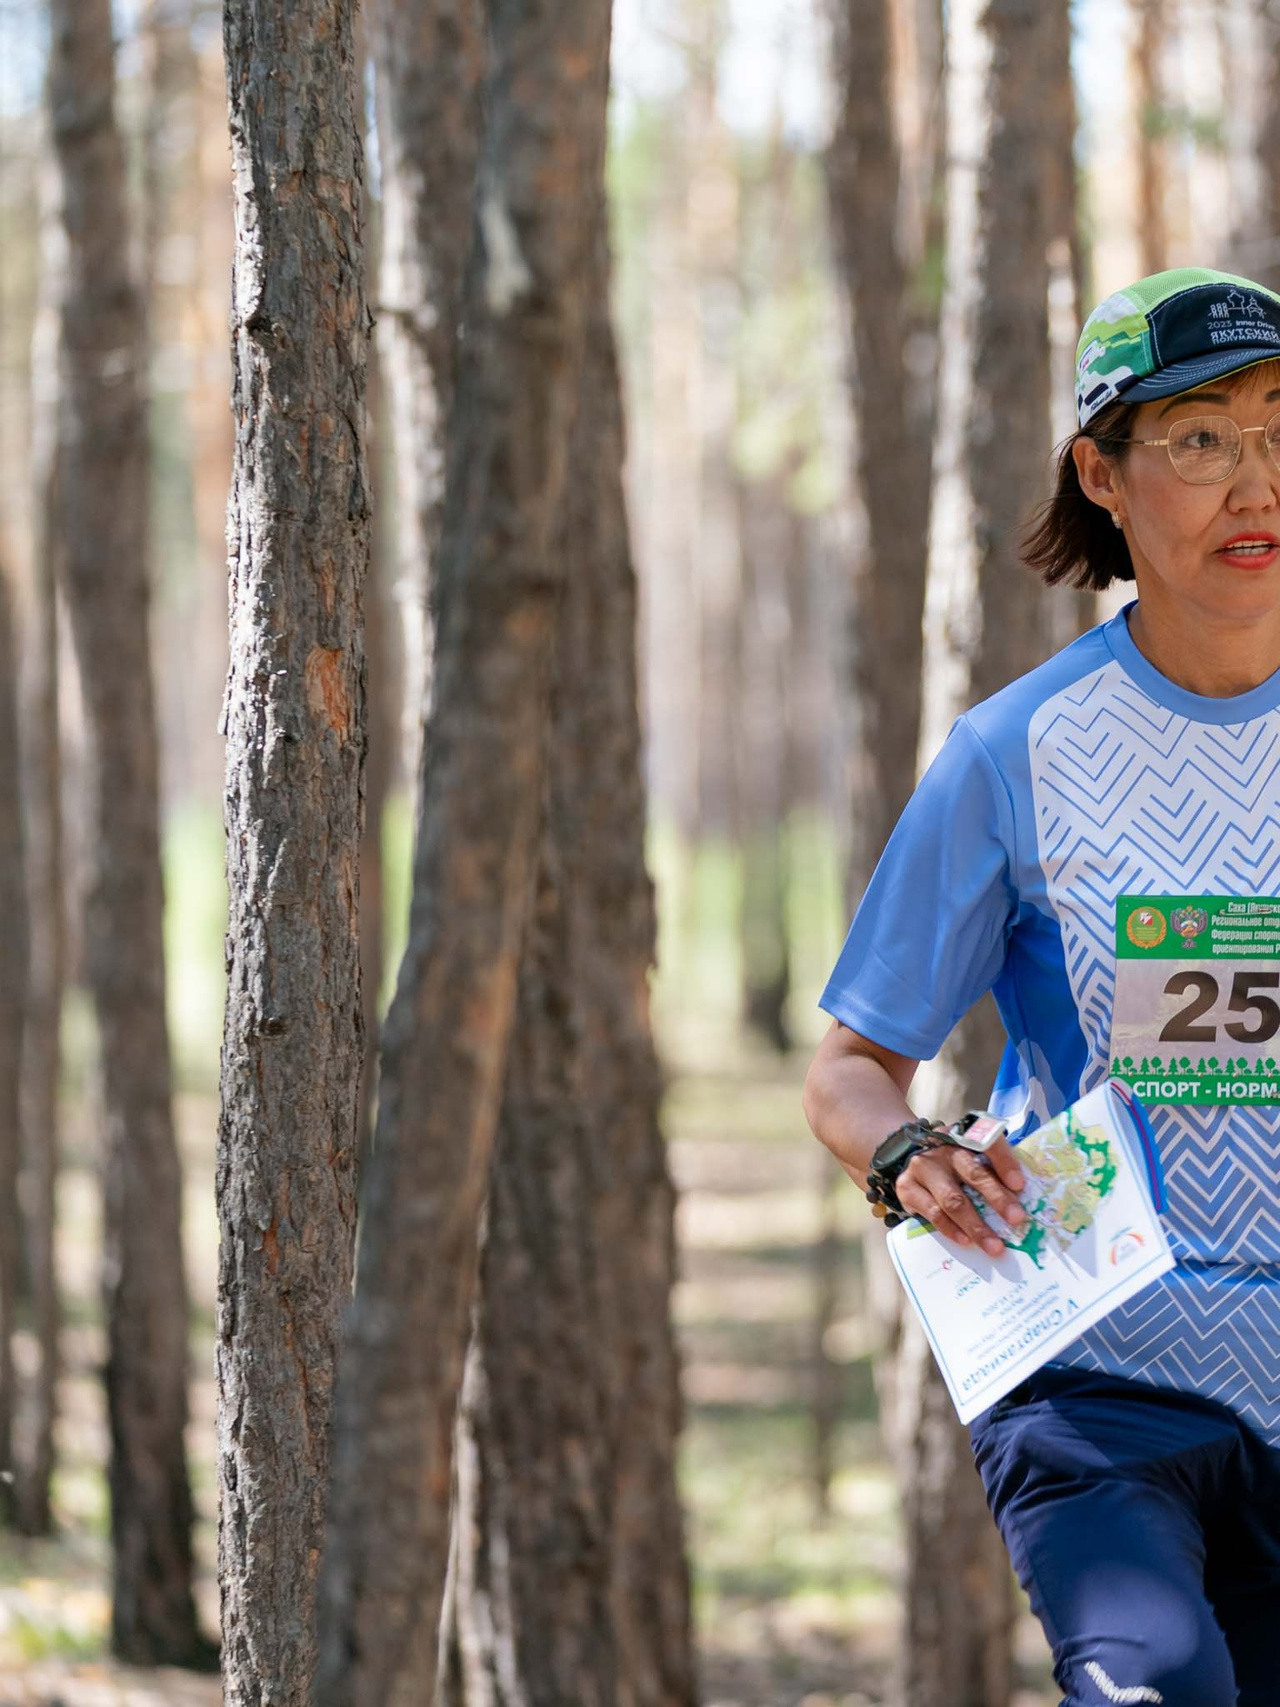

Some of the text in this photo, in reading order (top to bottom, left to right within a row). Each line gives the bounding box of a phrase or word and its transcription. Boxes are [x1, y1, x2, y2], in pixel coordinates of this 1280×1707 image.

[1207, 320, 1232, 330] 2023
[1257, 321, 1276, 331] Drive
[1210, 328, 1279, 341] ЯКУТСКИЙ
[1228, 902, 1246, 913] Саха
[1211, 915, 1262, 927] Региональное
[1211, 929, 1253, 942] Федерации
[1212, 944, 1274, 955] ориентирования
[1132, 1081, 1201, 1099] СПОРТ
